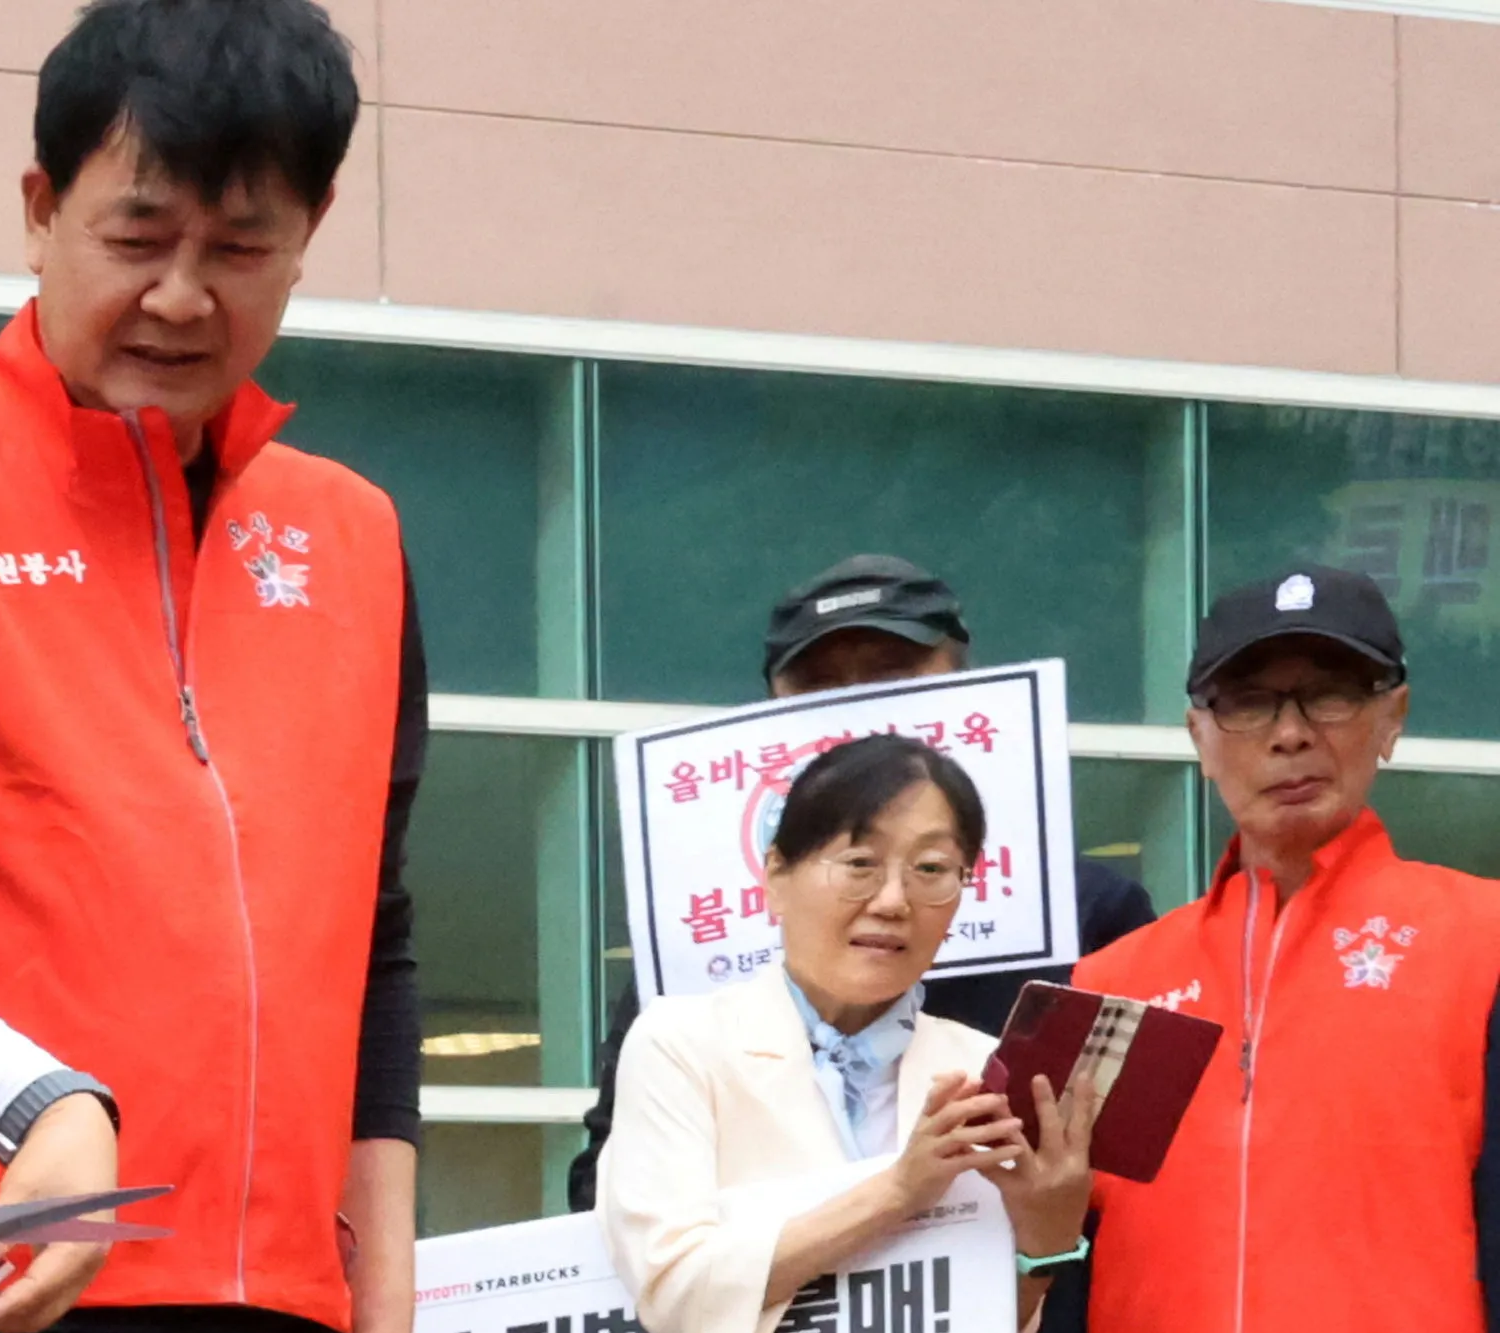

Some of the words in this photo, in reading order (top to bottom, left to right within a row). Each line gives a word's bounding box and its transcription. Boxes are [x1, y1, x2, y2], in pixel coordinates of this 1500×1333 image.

[663, 742, 796, 803] 올바른
[414, 1282, 471, 1303] OYCOTT!
[474, 1264, 581, 1293] STARBUCKS
